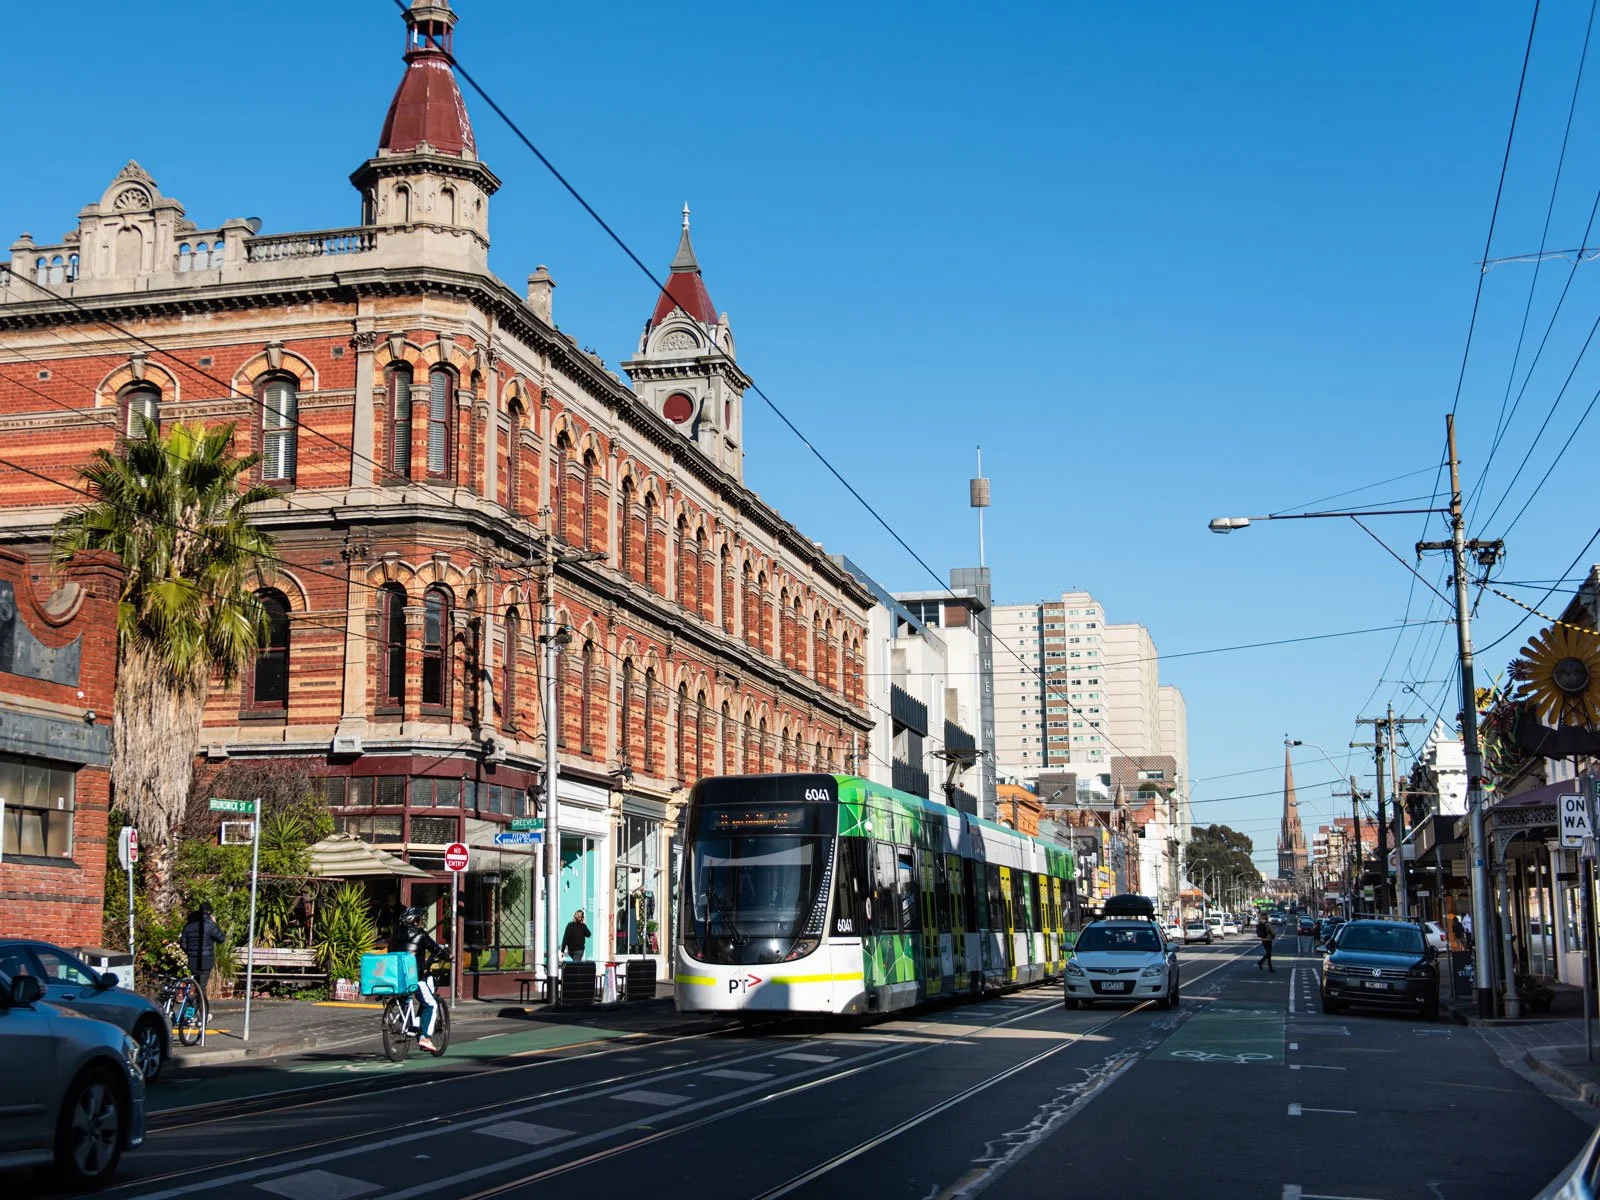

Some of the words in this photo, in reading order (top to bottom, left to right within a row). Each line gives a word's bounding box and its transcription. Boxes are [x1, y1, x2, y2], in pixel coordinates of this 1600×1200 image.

[983, 635, 991, 693] THE
[985, 729, 994, 786] MAX
[805, 788, 830, 801] 6041
[1565, 799, 1585, 812] ON
[512, 819, 537, 827] GREEVES
[1564, 815, 1586, 828] WA
[837, 918, 853, 932] 6041
